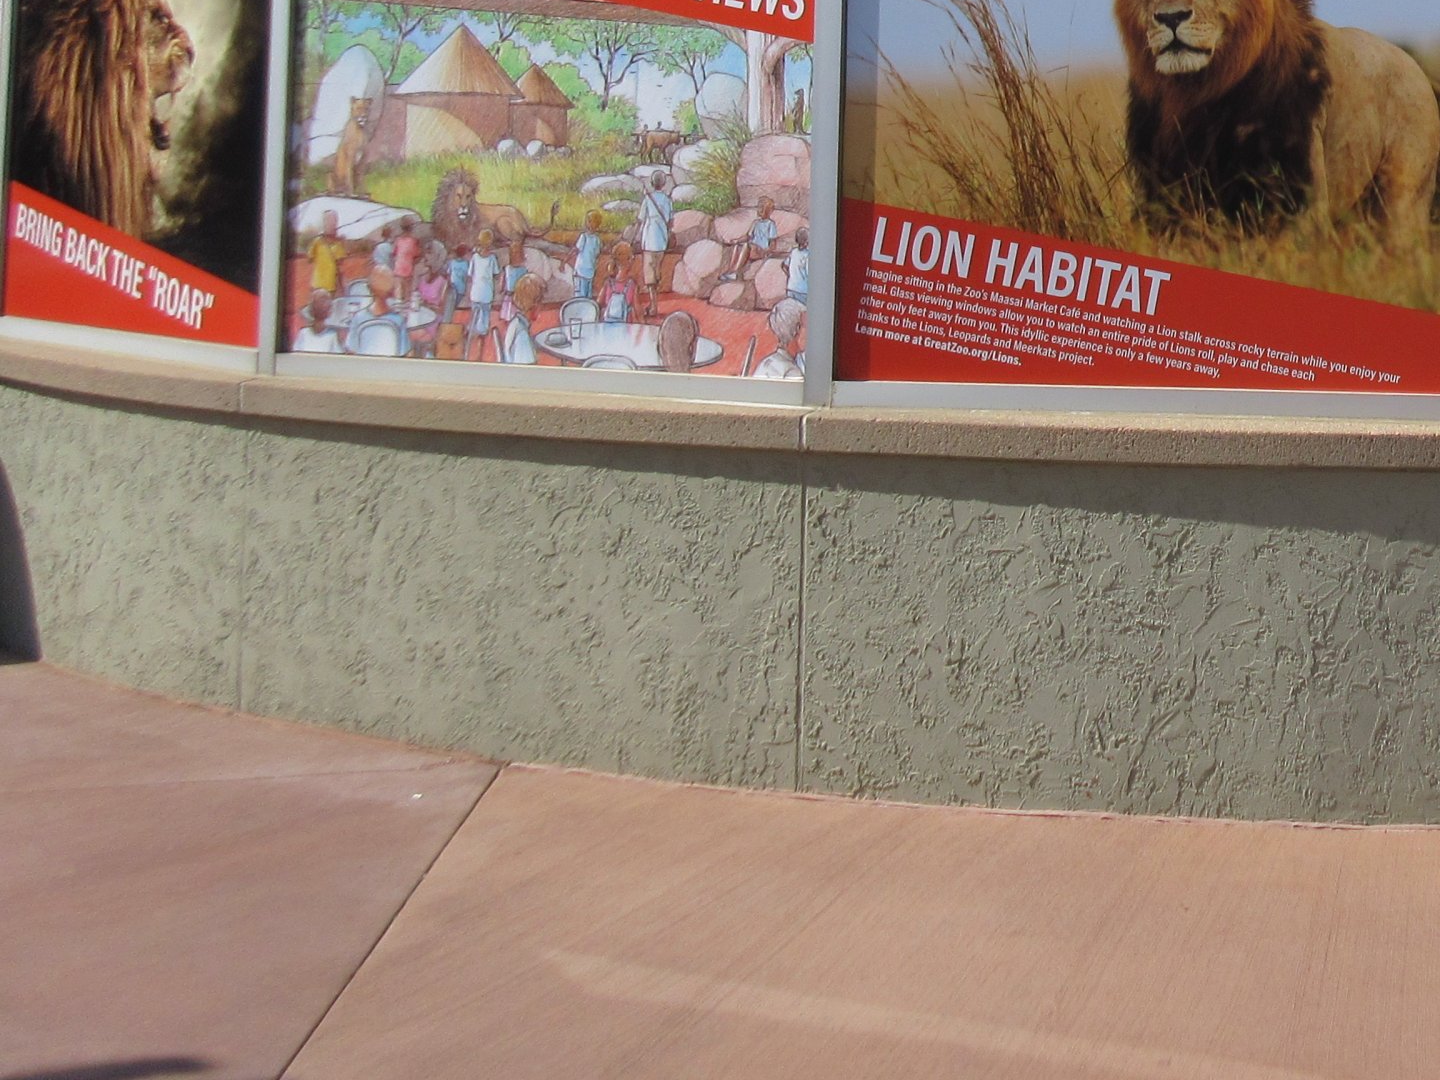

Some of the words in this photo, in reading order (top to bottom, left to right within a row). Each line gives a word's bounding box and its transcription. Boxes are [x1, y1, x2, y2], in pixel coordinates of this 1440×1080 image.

[15, 203, 64, 258] BRING
[65, 227, 110, 281] BACK
[111, 249, 146, 299] THE
[871, 216, 976, 279] LION
[985, 238, 1172, 316] HABITAT
[854, 322, 883, 337] Learn
[884, 329, 910, 343] more
[911, 334, 923, 345] at
[923, 336, 1021, 366] GreatZoo.org/Lions.
[857, 308, 889, 324] thanks
[890, 314, 900, 326] to
[901, 316, 917, 330] the
[947, 326, 991, 345] Leopards
[992, 337, 1012, 349] and
[1012, 339, 1057, 358] Meerkats
[859, 295, 885, 308] other
[885, 301, 907, 315] only
[907, 303, 927, 317] feet
[926, 309, 953, 324] away
[953, 312, 976, 327] from
[998, 321, 1019, 336] This
[1020, 325, 1049, 342] idyllic
[1050, 334, 1103, 352] experience
[1104, 342, 1113, 355] is
[1114, 347, 1136, 361] only
[1136, 351, 1144, 361] a
[1145, 351, 1164, 365] few
[1164, 357, 1192, 370] years
[865, 266, 903, 283] Imagine
[903, 274, 934, 291] sitting
[935, 279, 945, 292] in
[946, 282, 962, 295] the
[989, 290, 1024, 307] Maasai
[1024, 297, 1058, 314] Market
[1059, 304, 1080, 319] Café
[1081, 311, 1101, 322] and
[1102, 314, 1146, 334] watching
[1147, 324, 1154, 333] a
[1156, 323, 1177, 338] Lion
[1179, 329, 1203, 344] stalk
[1203, 336, 1236, 350] across
[1237, 342, 1265, 358] rocky
[1266, 346, 1299, 363] terrain
[1299, 355, 1327, 369] while
[1327, 361, 1347, 373] you
[1349, 365, 1376, 381] enjoy
[1377, 371, 1401, 384] your
[889, 285, 915, 300] Glass
[916, 291, 953, 310] viewing
[954, 299, 997, 317] windows
[998, 307, 1025, 322] allow
[1025, 314, 1044, 326] you
[1045, 316, 1055, 328] to
[1057, 320, 1086, 335] watch
[1087, 327, 1100, 337] an
[1101, 329, 1130, 343] entire
[1131, 334, 1157, 349] pride
[1158, 340, 1169, 351] of
[1169, 341, 1196, 357] Lions
[1216, 352, 1239, 368] play
[1239, 357, 1259, 370] and
[1259, 361, 1289, 376] chase
[1290, 368, 1315, 381] each
